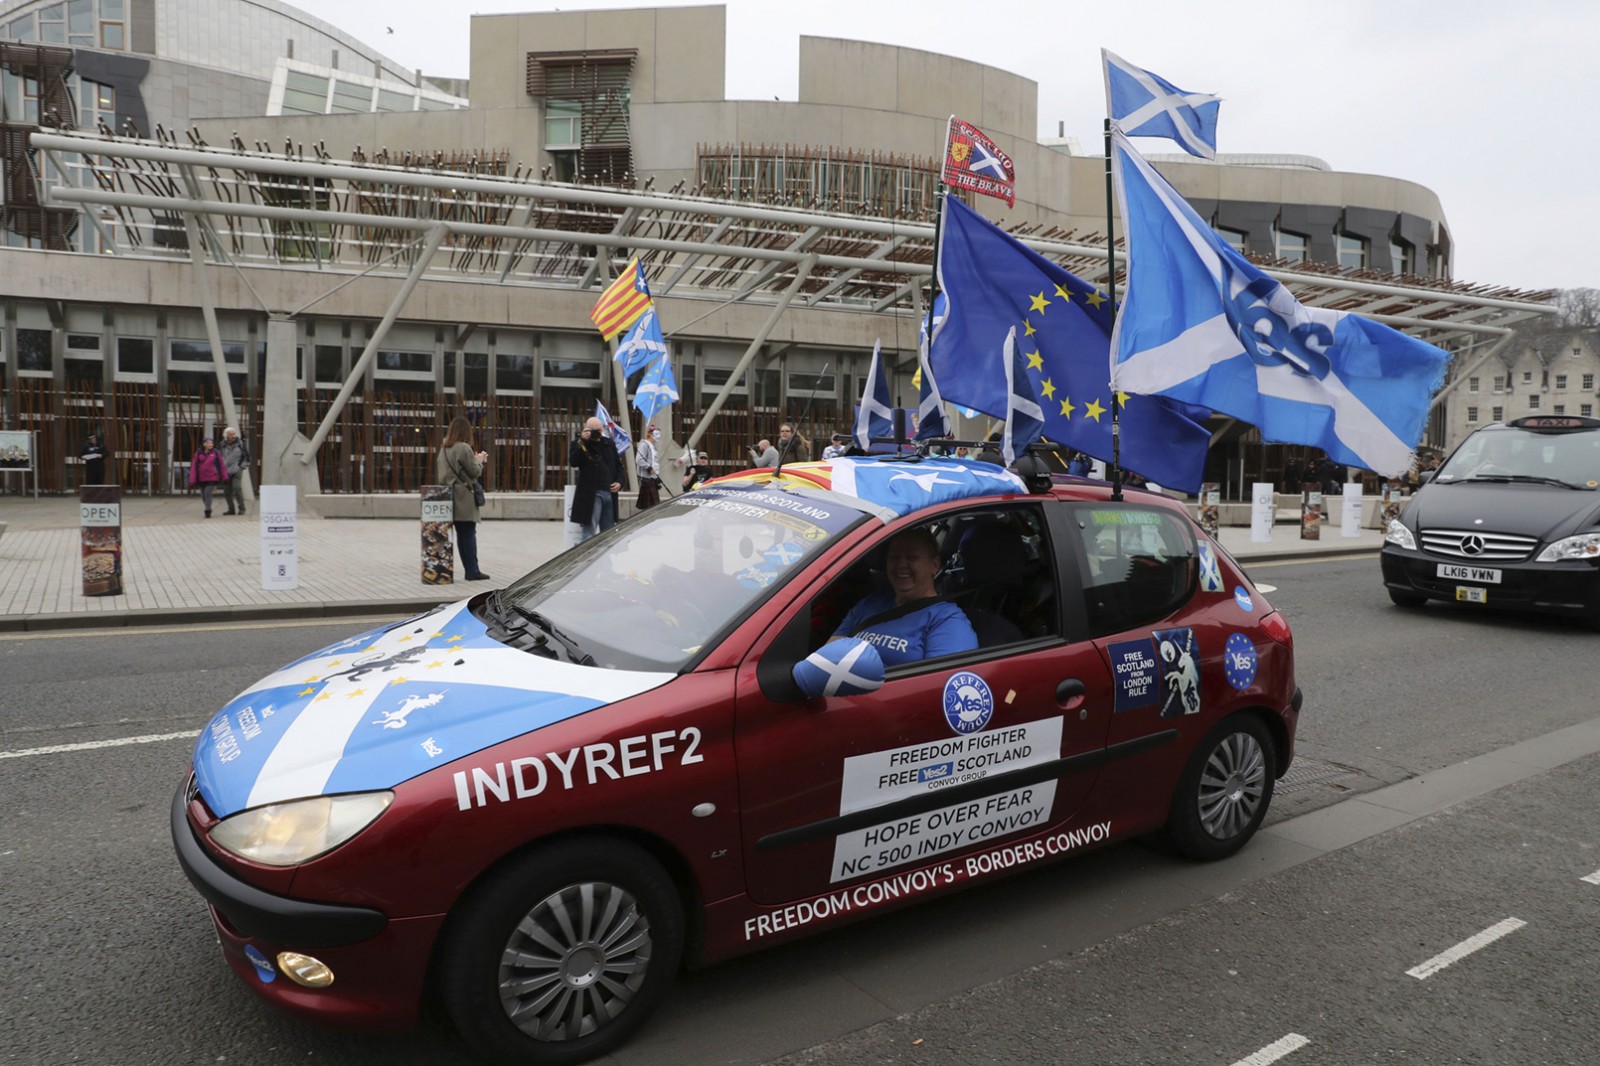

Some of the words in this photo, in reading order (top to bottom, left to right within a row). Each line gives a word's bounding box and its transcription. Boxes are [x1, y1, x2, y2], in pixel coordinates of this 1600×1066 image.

[957, 174, 976, 187] THE
[978, 181, 1012, 197] BRAVE
[1537, 418, 1570, 426] TAXI
[82, 507, 117, 519] OPEN
[424, 504, 454, 515] OPEN
[715, 500, 770, 518] FIGHTER
[744, 491, 768, 502] FOR
[765, 495, 830, 521] SCOTLAND
[1443, 565, 1468, 578] LK16
[1471, 568, 1494, 581] VWN
[857, 631, 908, 653] IGHTER
[1116, 659, 1154, 673] SCOTLAND
[1124, 651, 1143, 662] FREE
[1231, 652, 1251, 670] Yes
[1123, 675, 1152, 689] LONDON
[1130, 670, 1144, 678] FROM
[1128, 686, 1147, 698] RULE
[211, 714, 232, 742] CONVOY
[237, 706, 262, 741] FREEDOM
[216, 735, 241, 764] GROUP
[890, 741, 963, 767] FREEDOM
[968, 728, 1026, 751] FIGHTER
[453, 726, 704, 811] INDYREF2
[878, 769, 919, 789] FREE
[922, 764, 948, 780] Yes2
[957, 745, 1032, 772] SCOTLAND
[928, 777, 960, 789] CONVOY
[961, 770, 987, 783] GROUP
[864, 818, 922, 847] HOPE
[927, 804, 980, 830] OVER
[985, 789, 1033, 815] FEAR
[841, 855, 871, 876] NC
[877, 844, 912, 866] 500
[917, 830, 964, 856] INDY
[968, 806, 1044, 841] CONVOY
[744, 891, 850, 940] FREEDOM
[853, 863, 955, 907] CONVOY'S
[966, 840, 1045, 877] BORDERS
[1046, 821, 1112, 855] CONVOY
